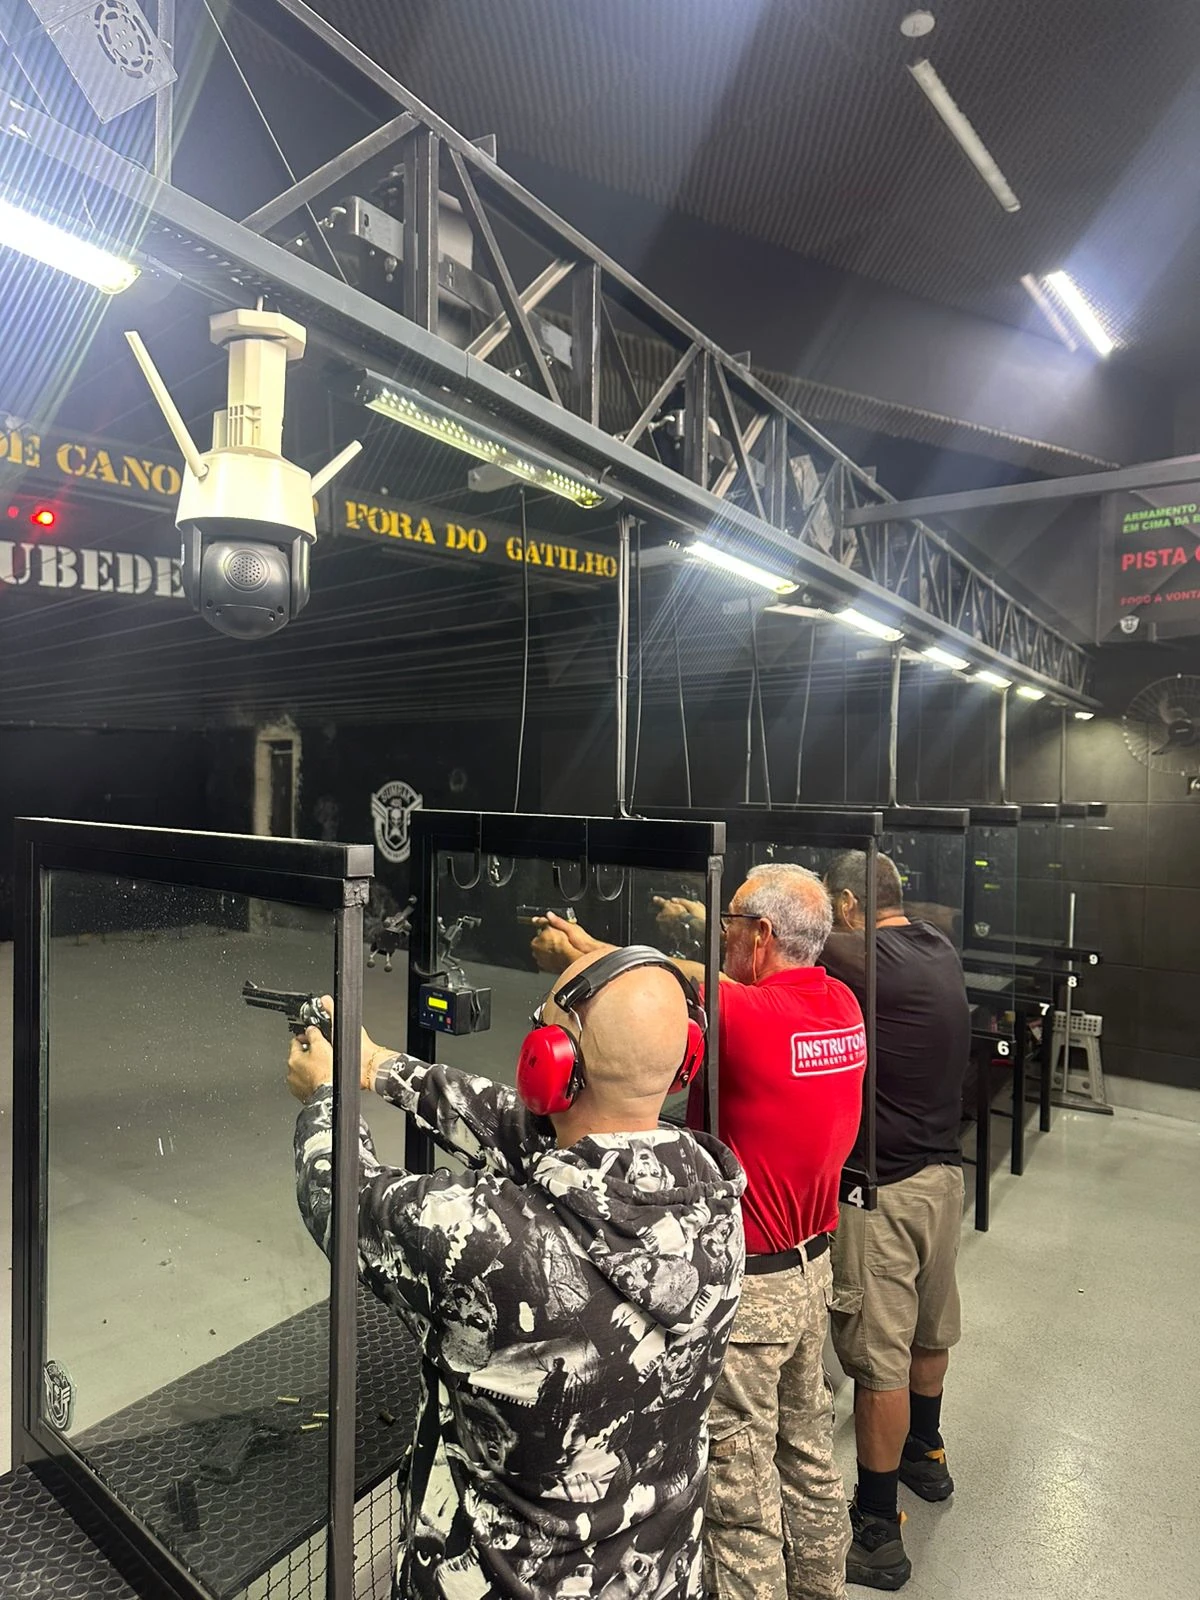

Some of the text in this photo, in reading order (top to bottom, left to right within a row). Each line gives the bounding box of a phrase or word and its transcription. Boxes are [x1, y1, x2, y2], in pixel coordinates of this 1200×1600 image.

[56, 443, 181, 496] CANO
[1124, 503, 1197, 523] ARMAMENTO
[1123, 522, 1139, 534] EM
[1142, 518, 1171, 531] CIMA
[1174, 515, 1190, 526] DA
[346, 501, 436, 544] FORA
[445, 523, 488, 554] DO
[506, 535, 618, 578] GATILHO
[1122, 547, 1187, 571] PISTA
[1089, 954, 1098, 965] 9
[1067, 975, 1077, 988] 8
[1040, 1003, 1049, 1015] 7
[797, 1032, 864, 1059] INSTRUTOR
[998, 1041, 1009, 1056] 6
[798, 1054, 847, 1068] ARMAMENTO
[847, 1186, 864, 1208] 4
